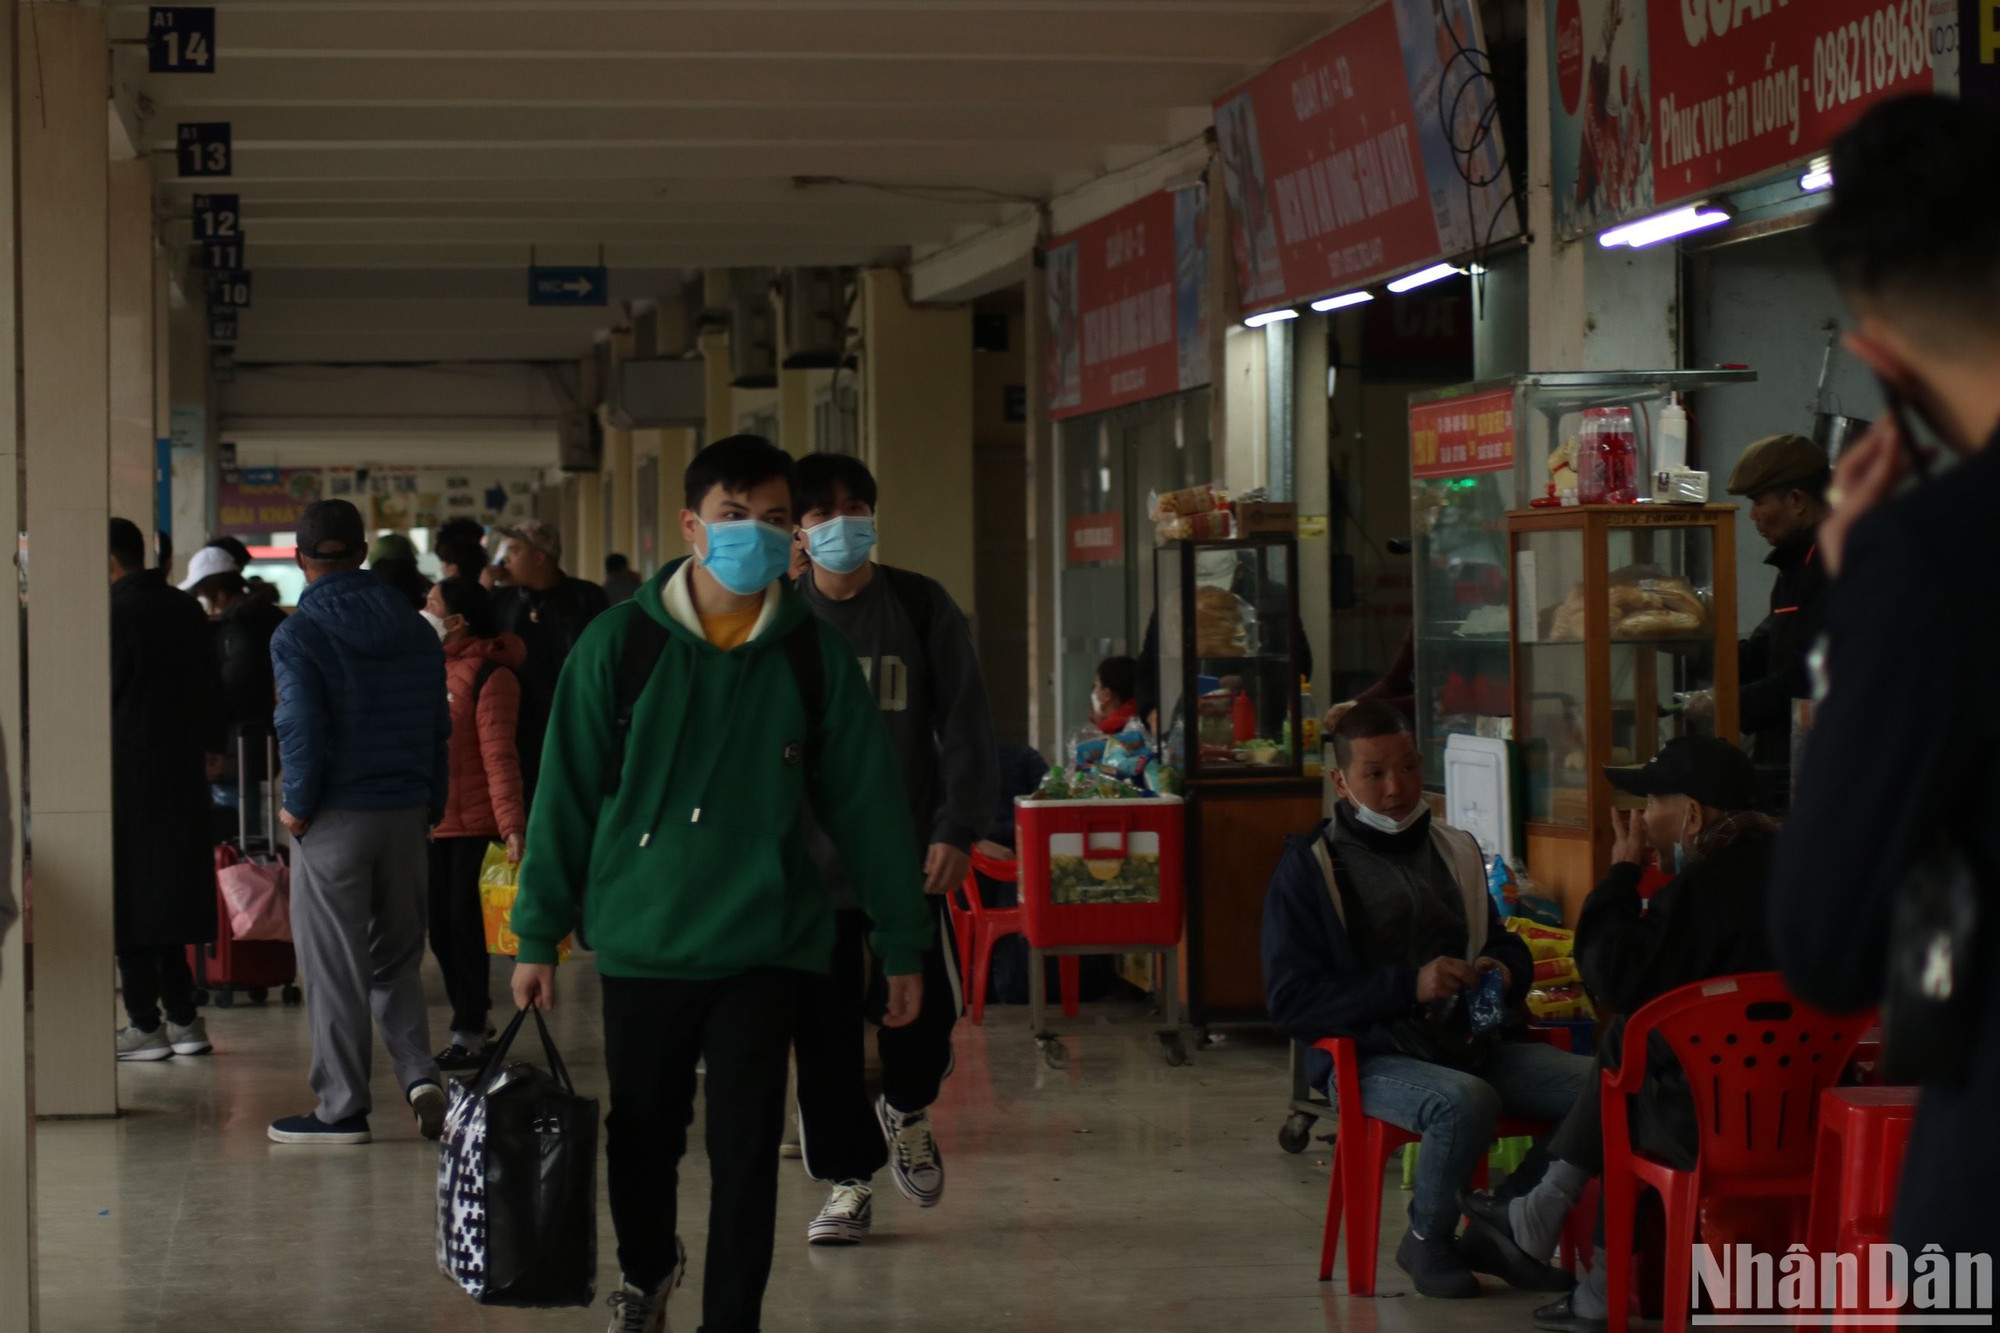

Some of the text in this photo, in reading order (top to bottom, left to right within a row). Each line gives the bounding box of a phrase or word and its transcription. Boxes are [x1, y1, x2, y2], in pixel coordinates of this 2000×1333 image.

[153, 11, 174, 27] A1
[161, 31, 210, 67] 14
[1659, 93, 1701, 184] Phục
[1701, 102, 1723, 175] vụ
[1726, 72, 1749, 143] ăn
[1752, 41, 1800, 146] uống
[180, 126, 199, 140] A1
[188, 142, 227, 172] 13
[202, 211, 236, 237] 12
[210, 245, 238, 268] 11
[221, 282, 249, 305] 10
